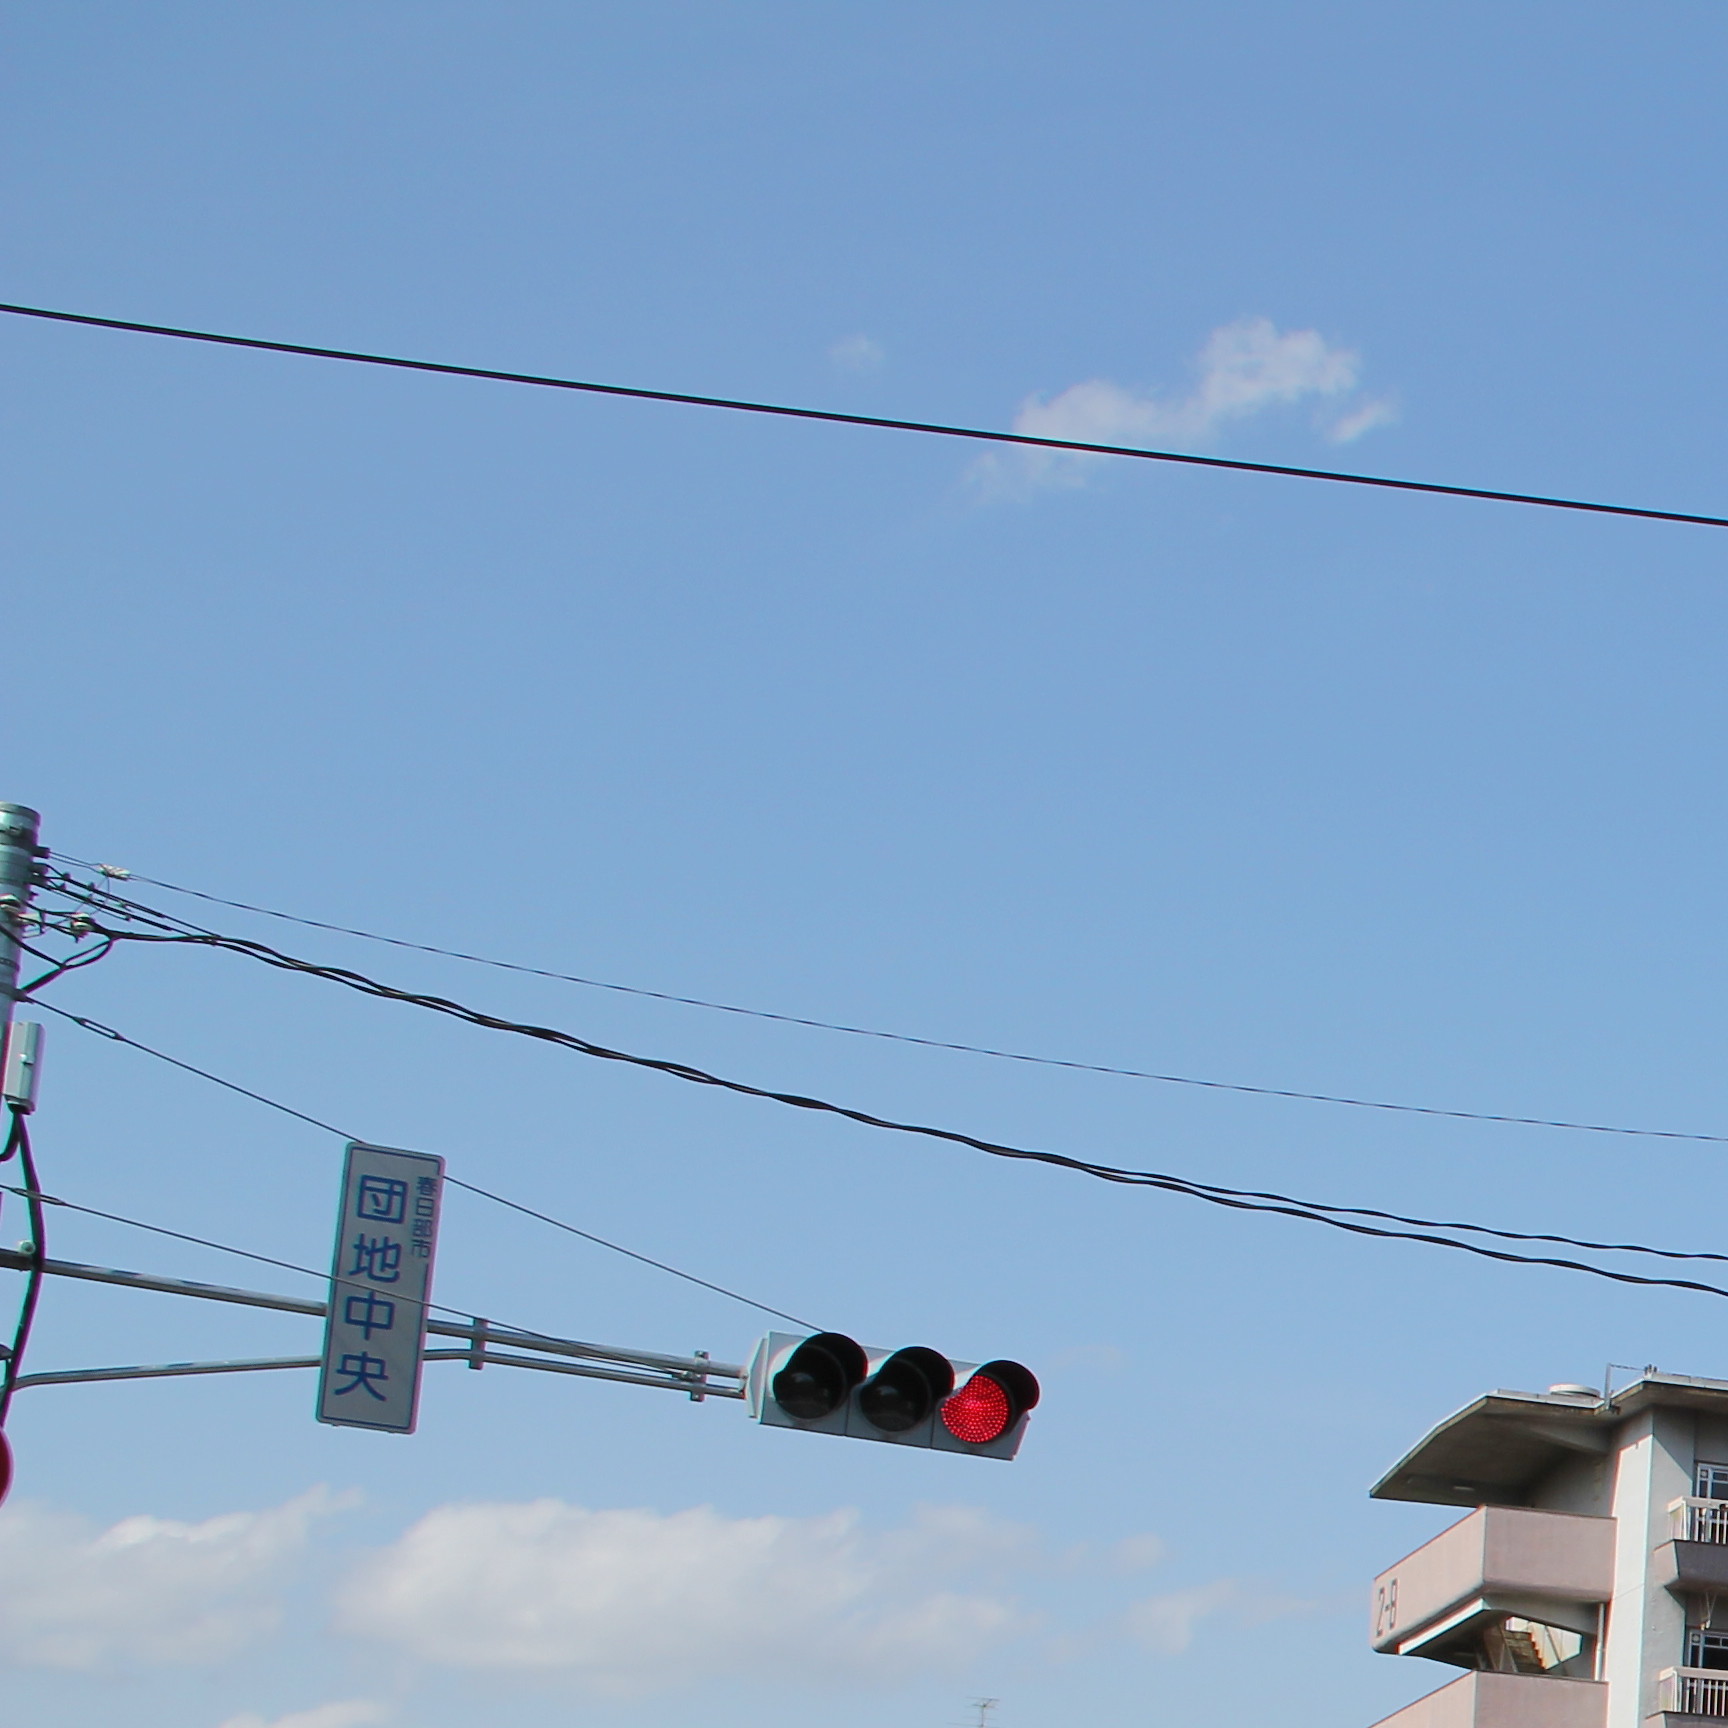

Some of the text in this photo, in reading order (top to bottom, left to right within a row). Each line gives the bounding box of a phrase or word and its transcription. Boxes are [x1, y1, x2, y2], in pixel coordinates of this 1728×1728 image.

[334, 1174, 408, 1402] 団地中央
[411, 1176, 437, 1259] 春日部市
